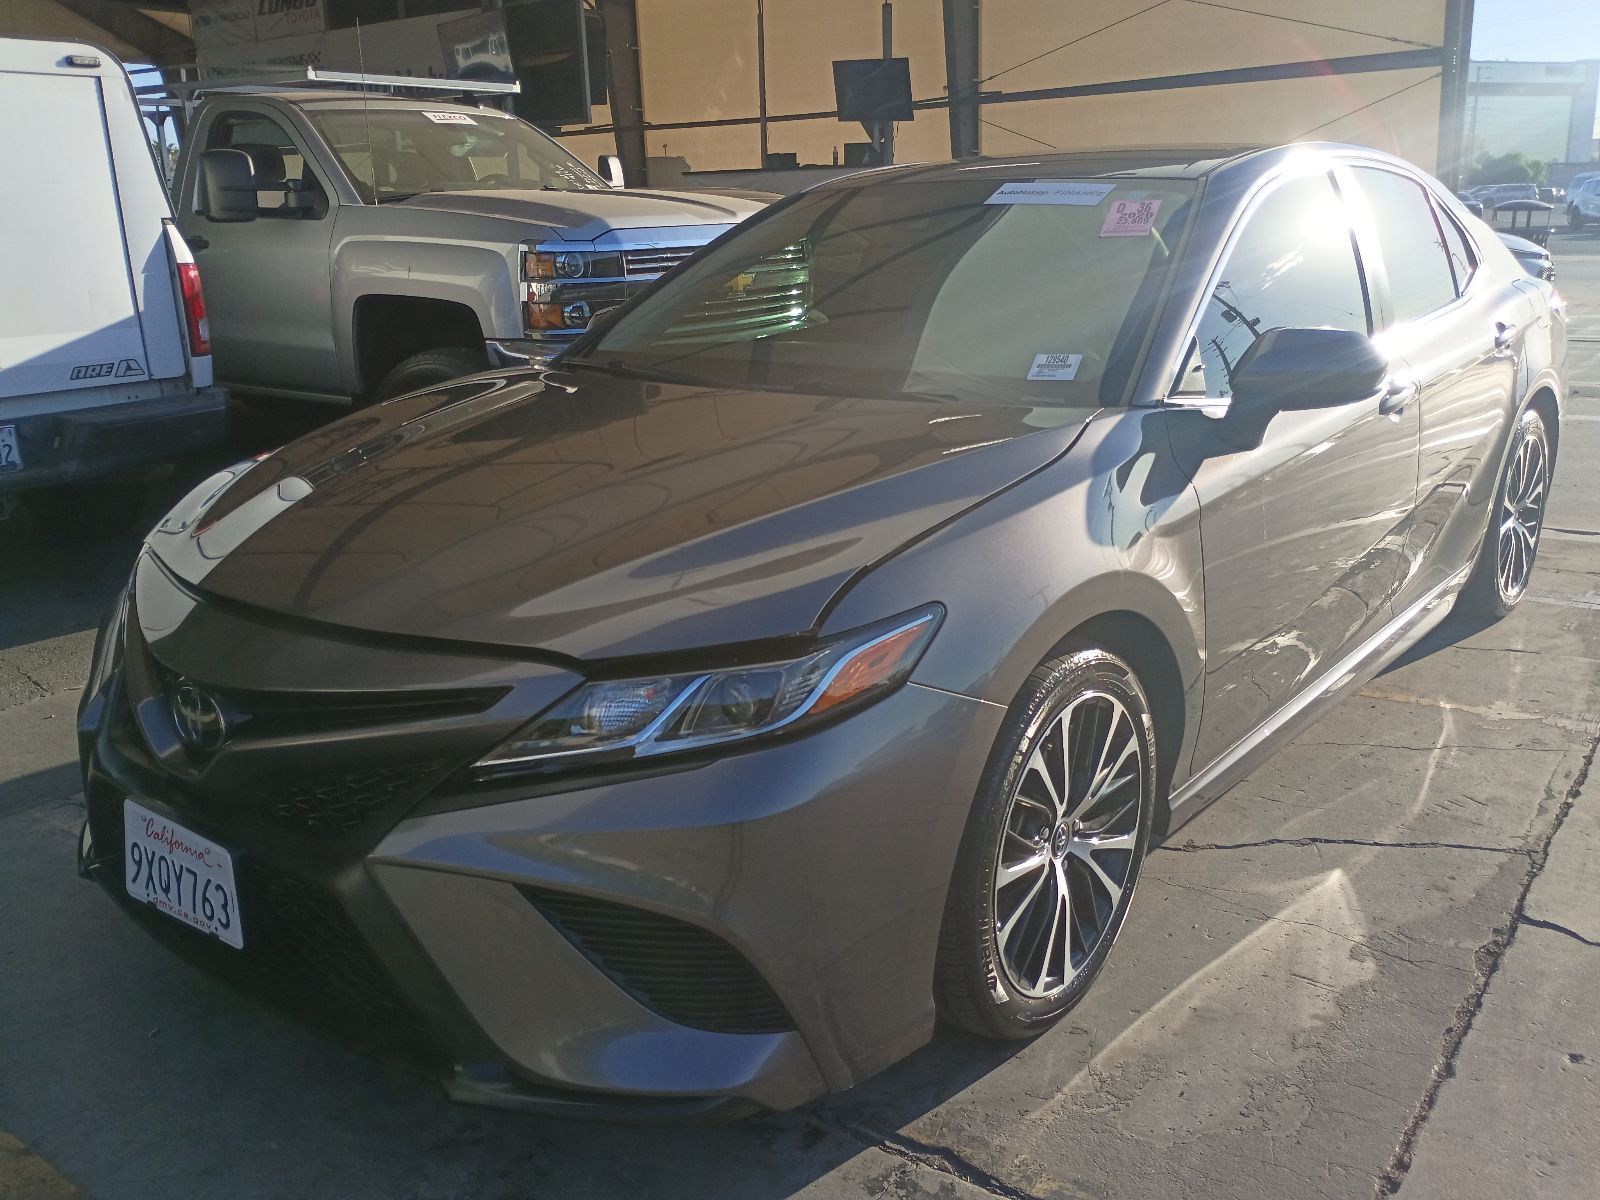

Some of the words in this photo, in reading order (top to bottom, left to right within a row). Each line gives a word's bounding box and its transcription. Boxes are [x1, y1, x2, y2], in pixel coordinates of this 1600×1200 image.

[70, 362, 115, 380] ARE
[145, 817, 213, 868] California
[130, 841, 231, 930] 9XQY763
[152, 896, 212, 930] dmv.ca.gov
